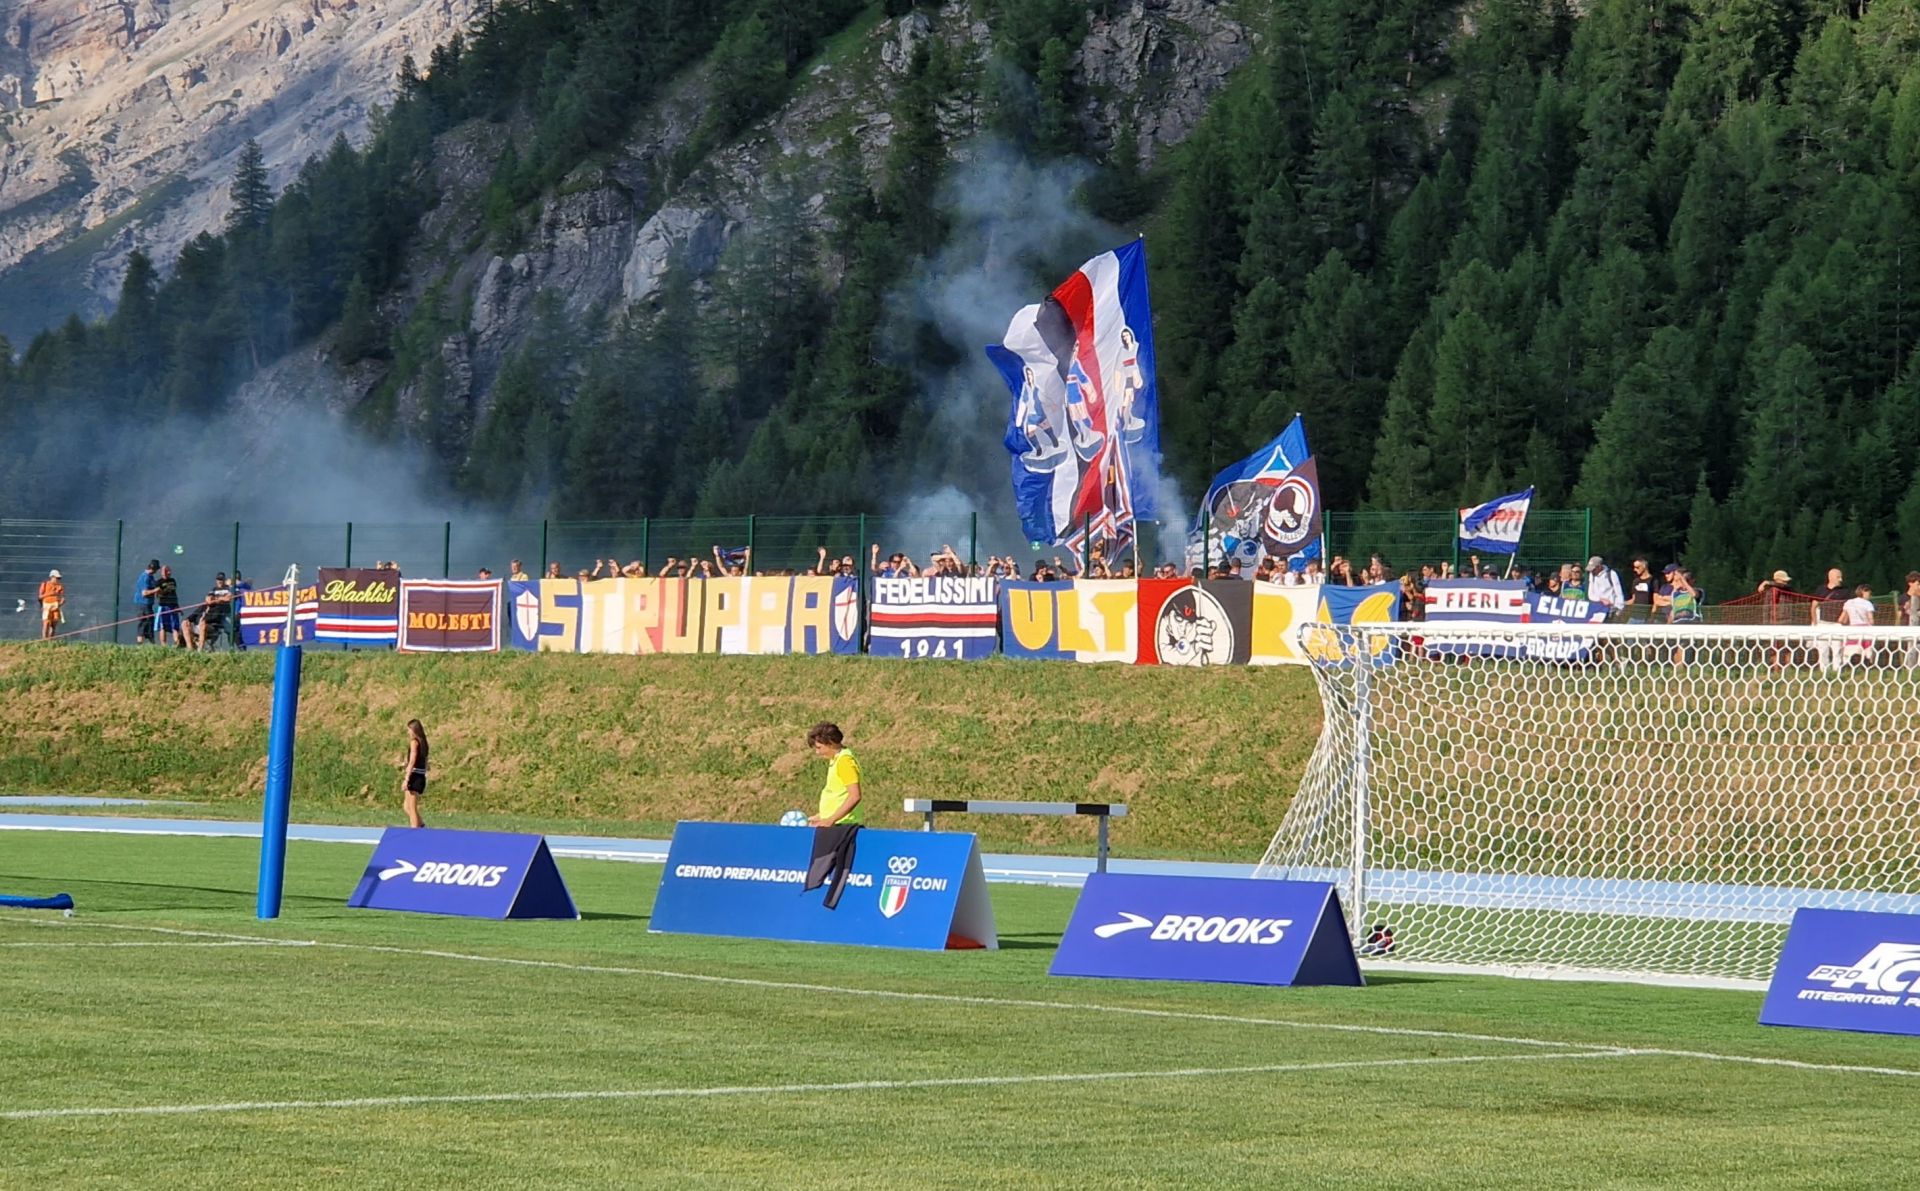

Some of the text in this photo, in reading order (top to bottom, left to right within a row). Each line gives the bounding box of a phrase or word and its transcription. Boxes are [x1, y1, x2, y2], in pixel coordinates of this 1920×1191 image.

[319, 579, 397, 603] Blacklist
[875, 576, 994, 604] FEDELISSIMI
[1446, 592, 1500, 609] FIERI
[408, 612, 491, 631] MOLESTI
[538, 576, 835, 654] STRUPPA
[900, 638, 964, 659] 1961
[412, 861, 508, 887] BROOKS
[675, 864, 722, 879] CENTRO
[722, 867, 807, 883] PREPARAZION
[912, 877, 947, 891] CONI
[1150, 914, 1293, 944] BROOKS
[1797, 989, 1900, 1005] INTEGRATORI
